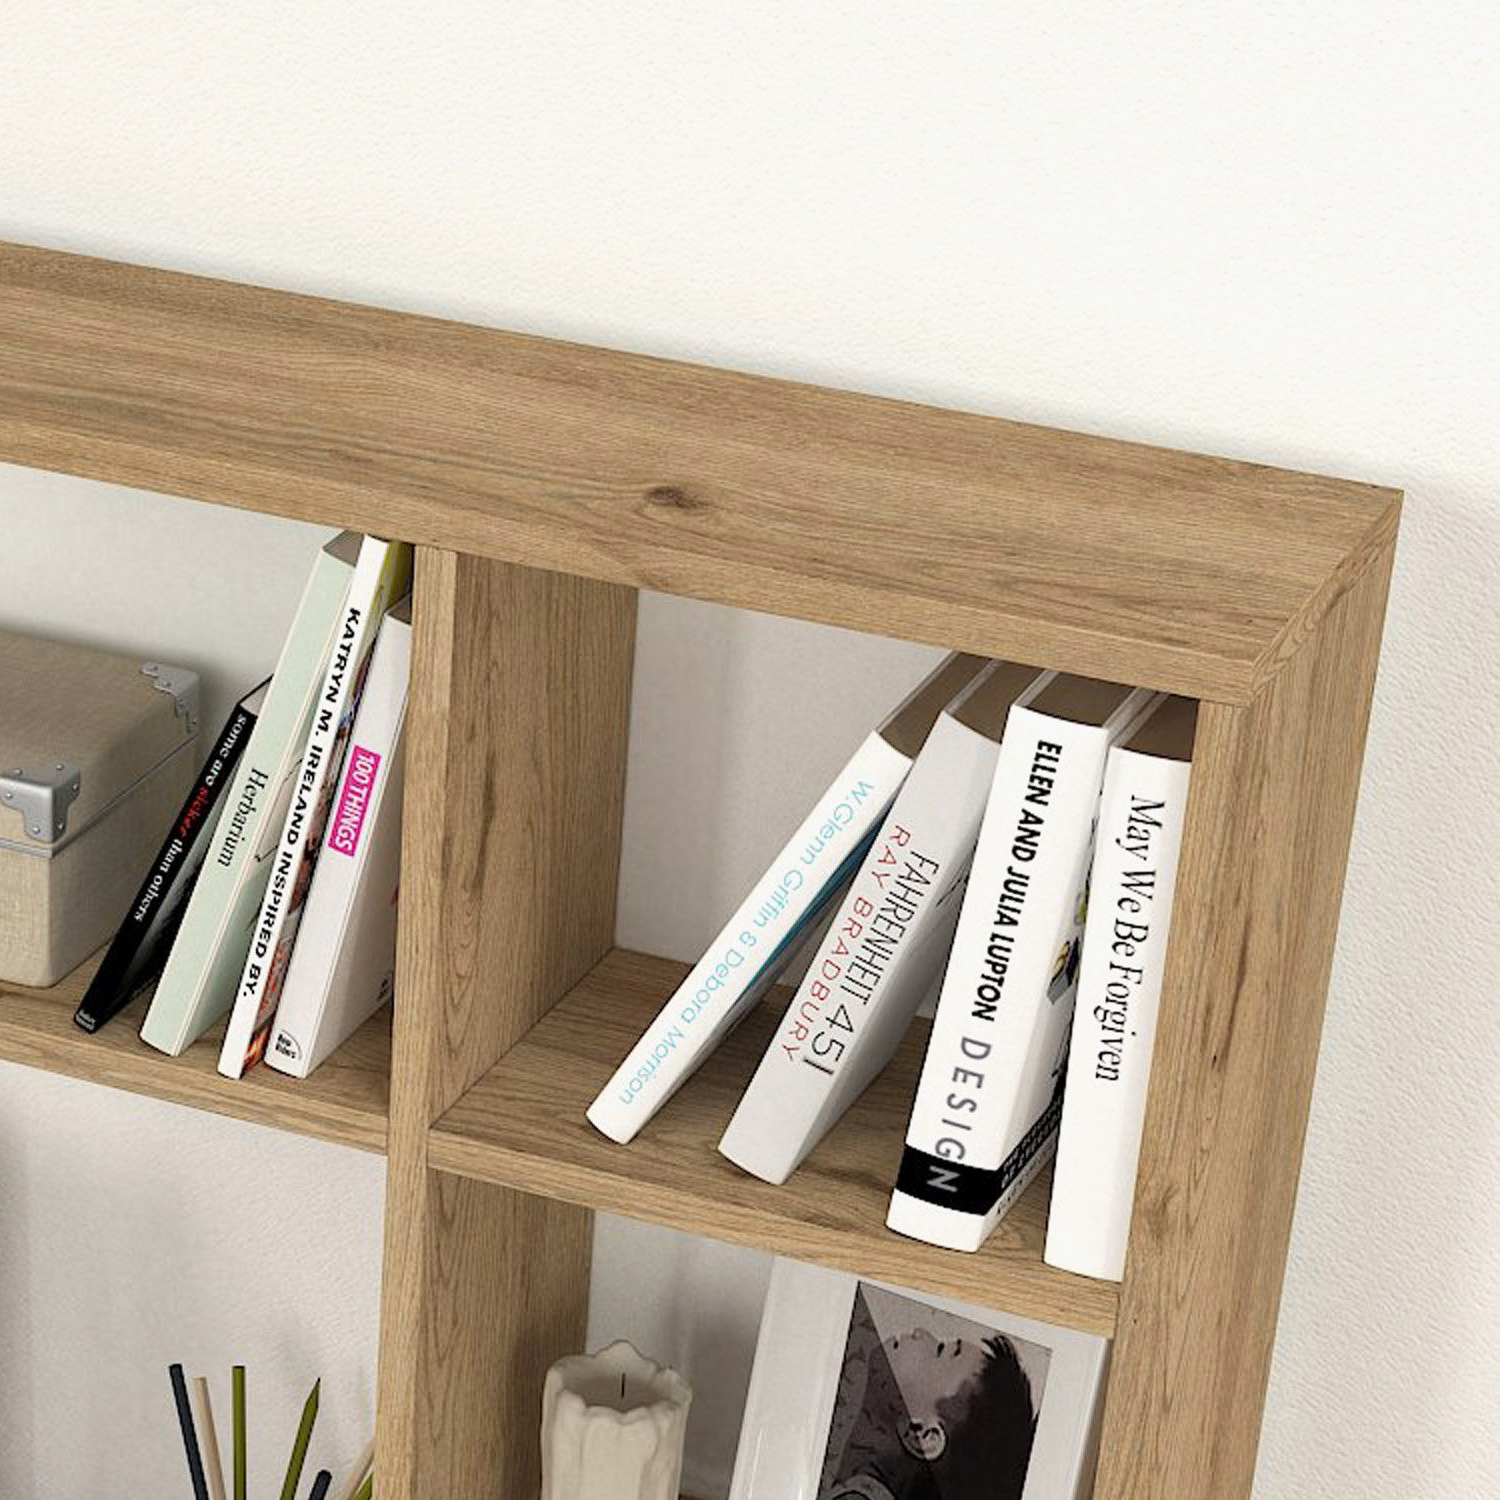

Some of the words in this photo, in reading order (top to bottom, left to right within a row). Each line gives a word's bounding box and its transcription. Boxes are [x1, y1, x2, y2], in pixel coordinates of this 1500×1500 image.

[325, 608, 361, 703] KATRYN
[219, 713, 247, 758] some
[315, 710, 333, 737] M.
[205, 760, 223, 787] are
[287, 744, 323, 845] IRELAND
[1024, 740, 1063, 807] ELLEN
[179, 787, 210, 838] sicker
[217, 767, 269, 867] Herbarium
[334, 782, 368, 852] THINGS
[1011, 808, 1045, 862] AND
[1115, 794, 1166, 860] May
[159, 839, 184, 873] than
[871, 824, 912, 889] RAY
[133, 874, 163, 922] others
[254, 851, 293, 958] INSPIRED
[752, 868, 804, 929] Griffin
[993, 866, 1030, 927] JULIA
[1117, 869, 1157, 914] We
[840, 850, 940, 1006] FAHRENHEIT
[1111, 918, 1149, 958] Be
[243, 963, 262, 997] BY.
[680, 949, 745, 1026] Debora
[781, 896, 874, 1063] BRADBURY
[971, 932, 1015, 1022] LUPTON
[803, 1004, 855, 1076] 451
[1093, 961, 1143, 1082] Forgiven
[619, 1026, 685, 1105] Morrison
[926, 1036, 992, 1192] DESIGN
